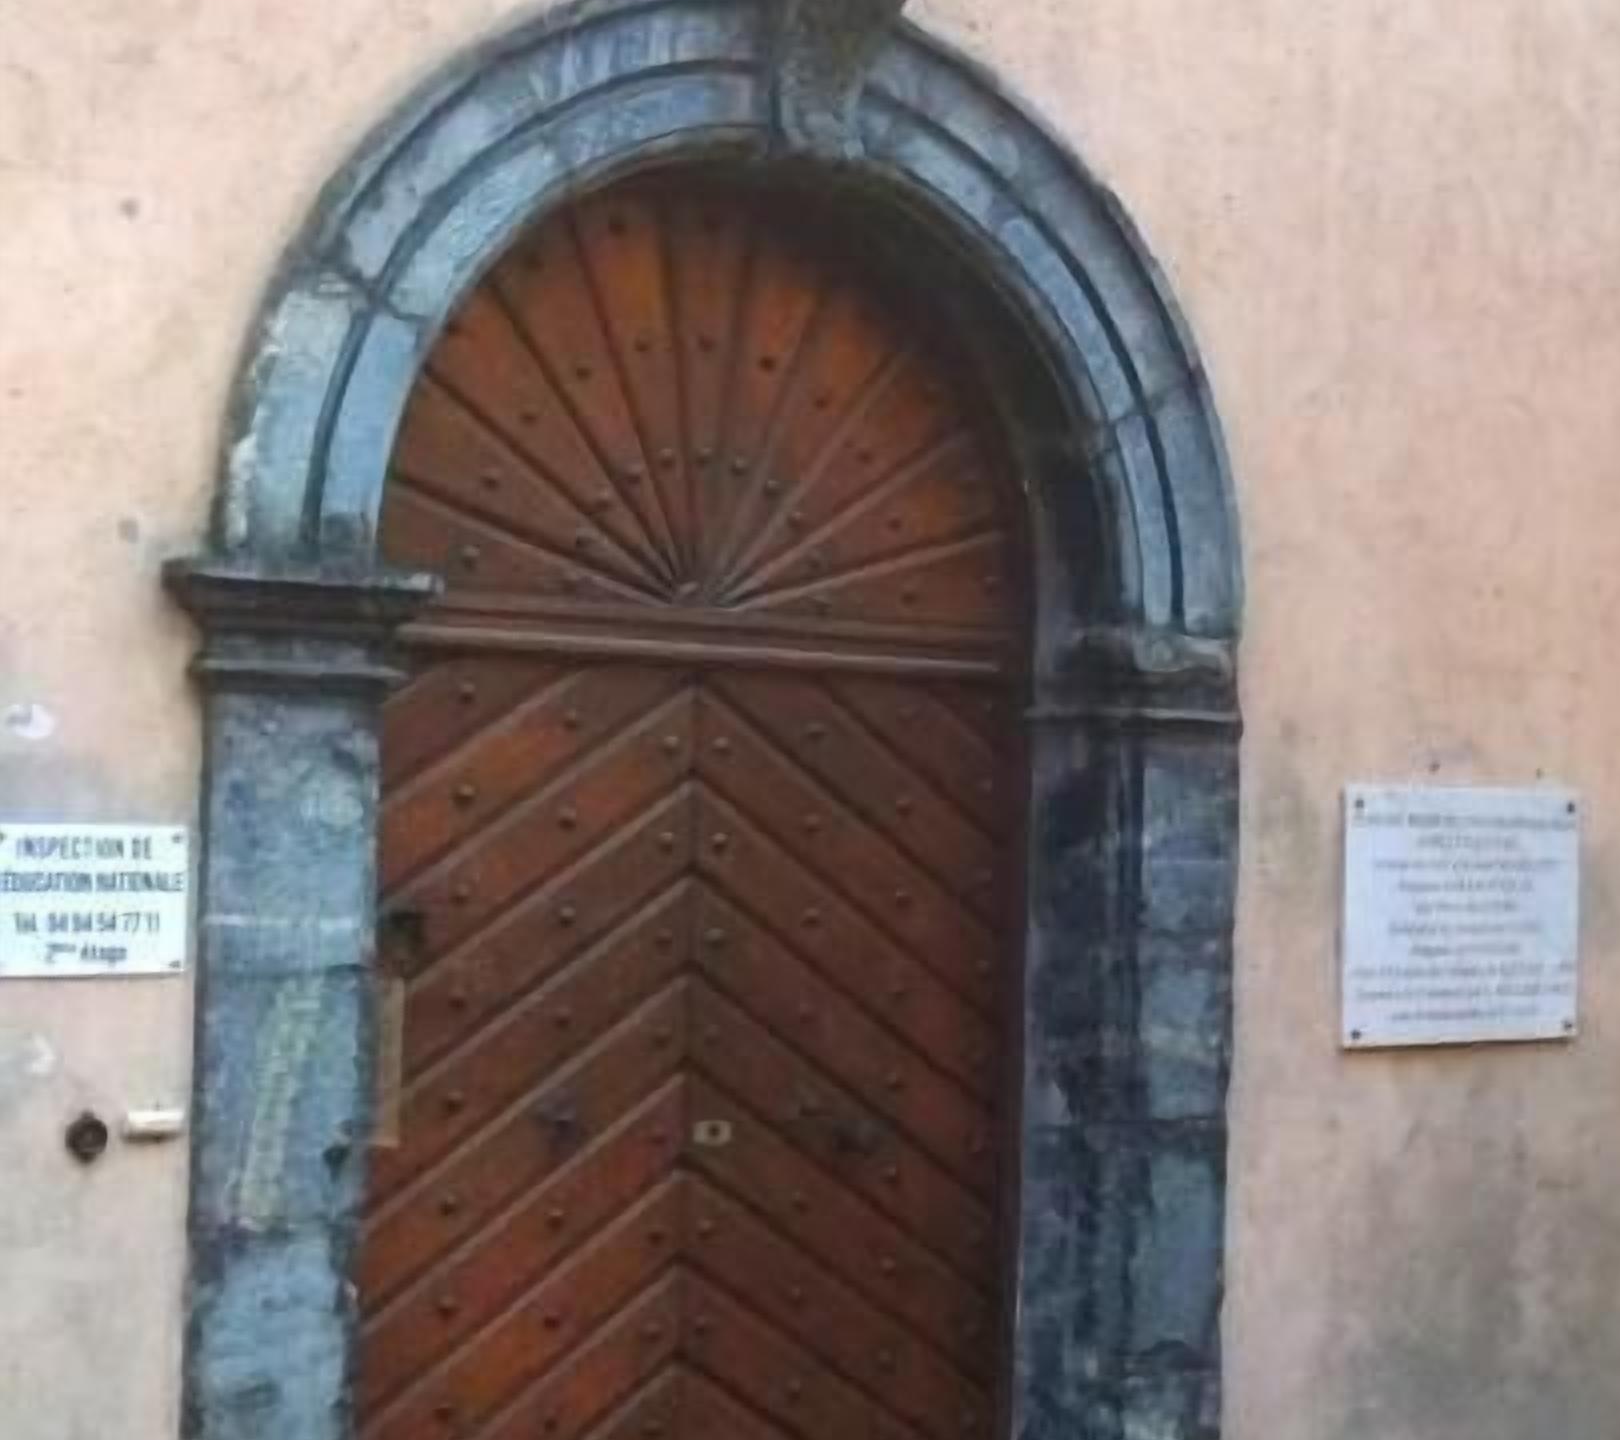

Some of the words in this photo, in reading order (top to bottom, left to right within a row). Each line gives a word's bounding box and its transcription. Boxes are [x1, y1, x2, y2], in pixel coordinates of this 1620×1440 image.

[16, 837, 124, 859] INSPECTION
[131, 837, 152, 859] DE
[96, 871, 184, 891] NATIONALE
